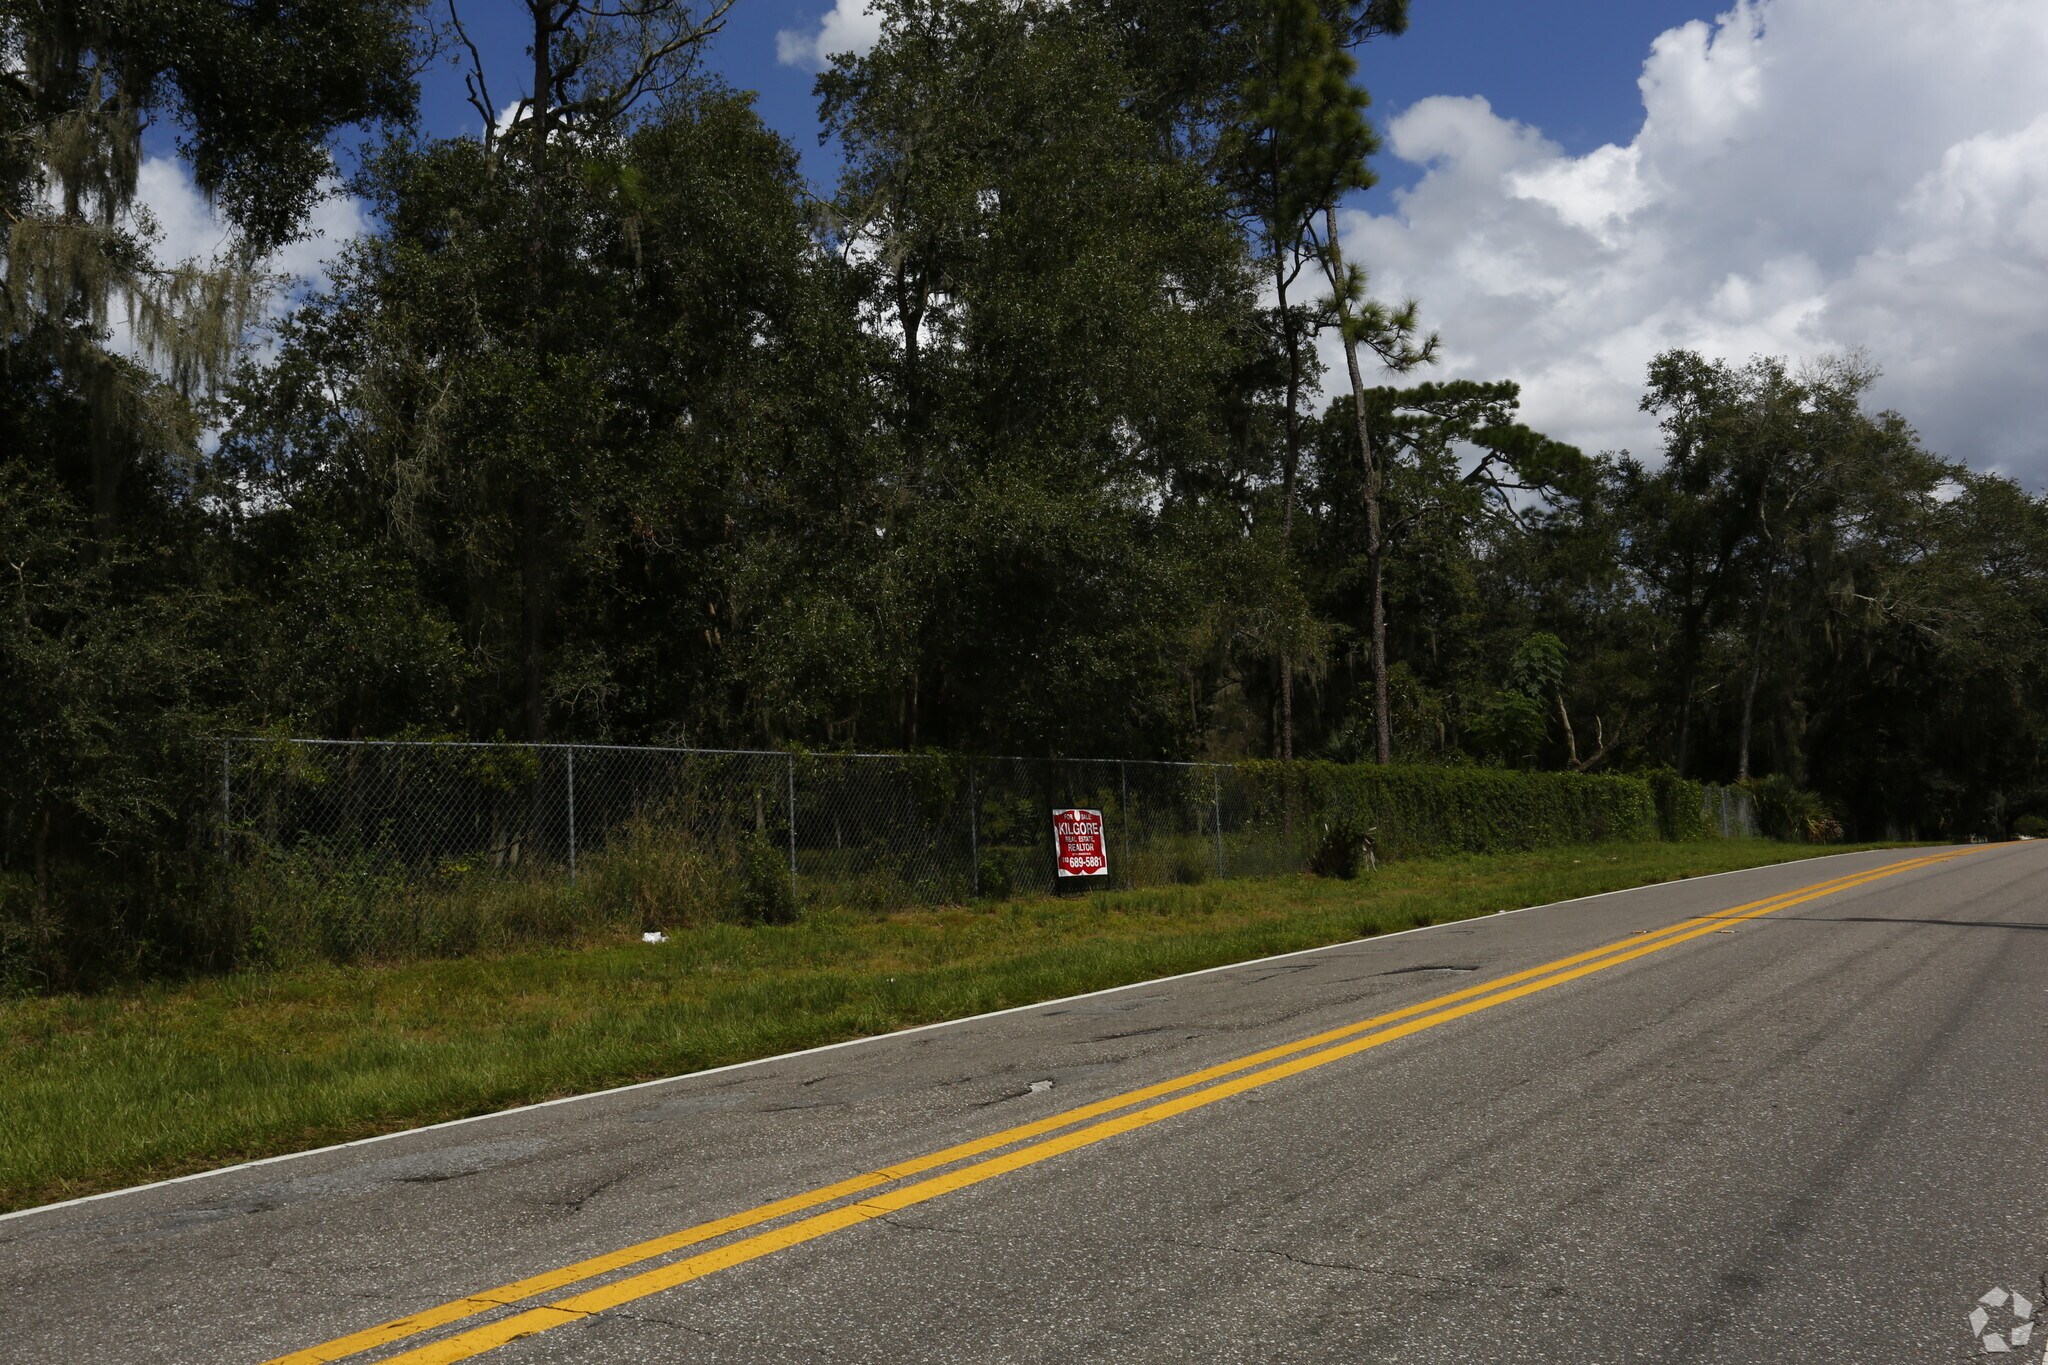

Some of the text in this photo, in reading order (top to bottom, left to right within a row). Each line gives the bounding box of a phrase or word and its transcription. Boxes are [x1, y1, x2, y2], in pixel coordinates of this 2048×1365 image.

[1058, 822, 1099, 835] KILGORE
[1068, 843, 1094, 851] REALTOR
[1069, 856, 1102, 868] 689-5881
